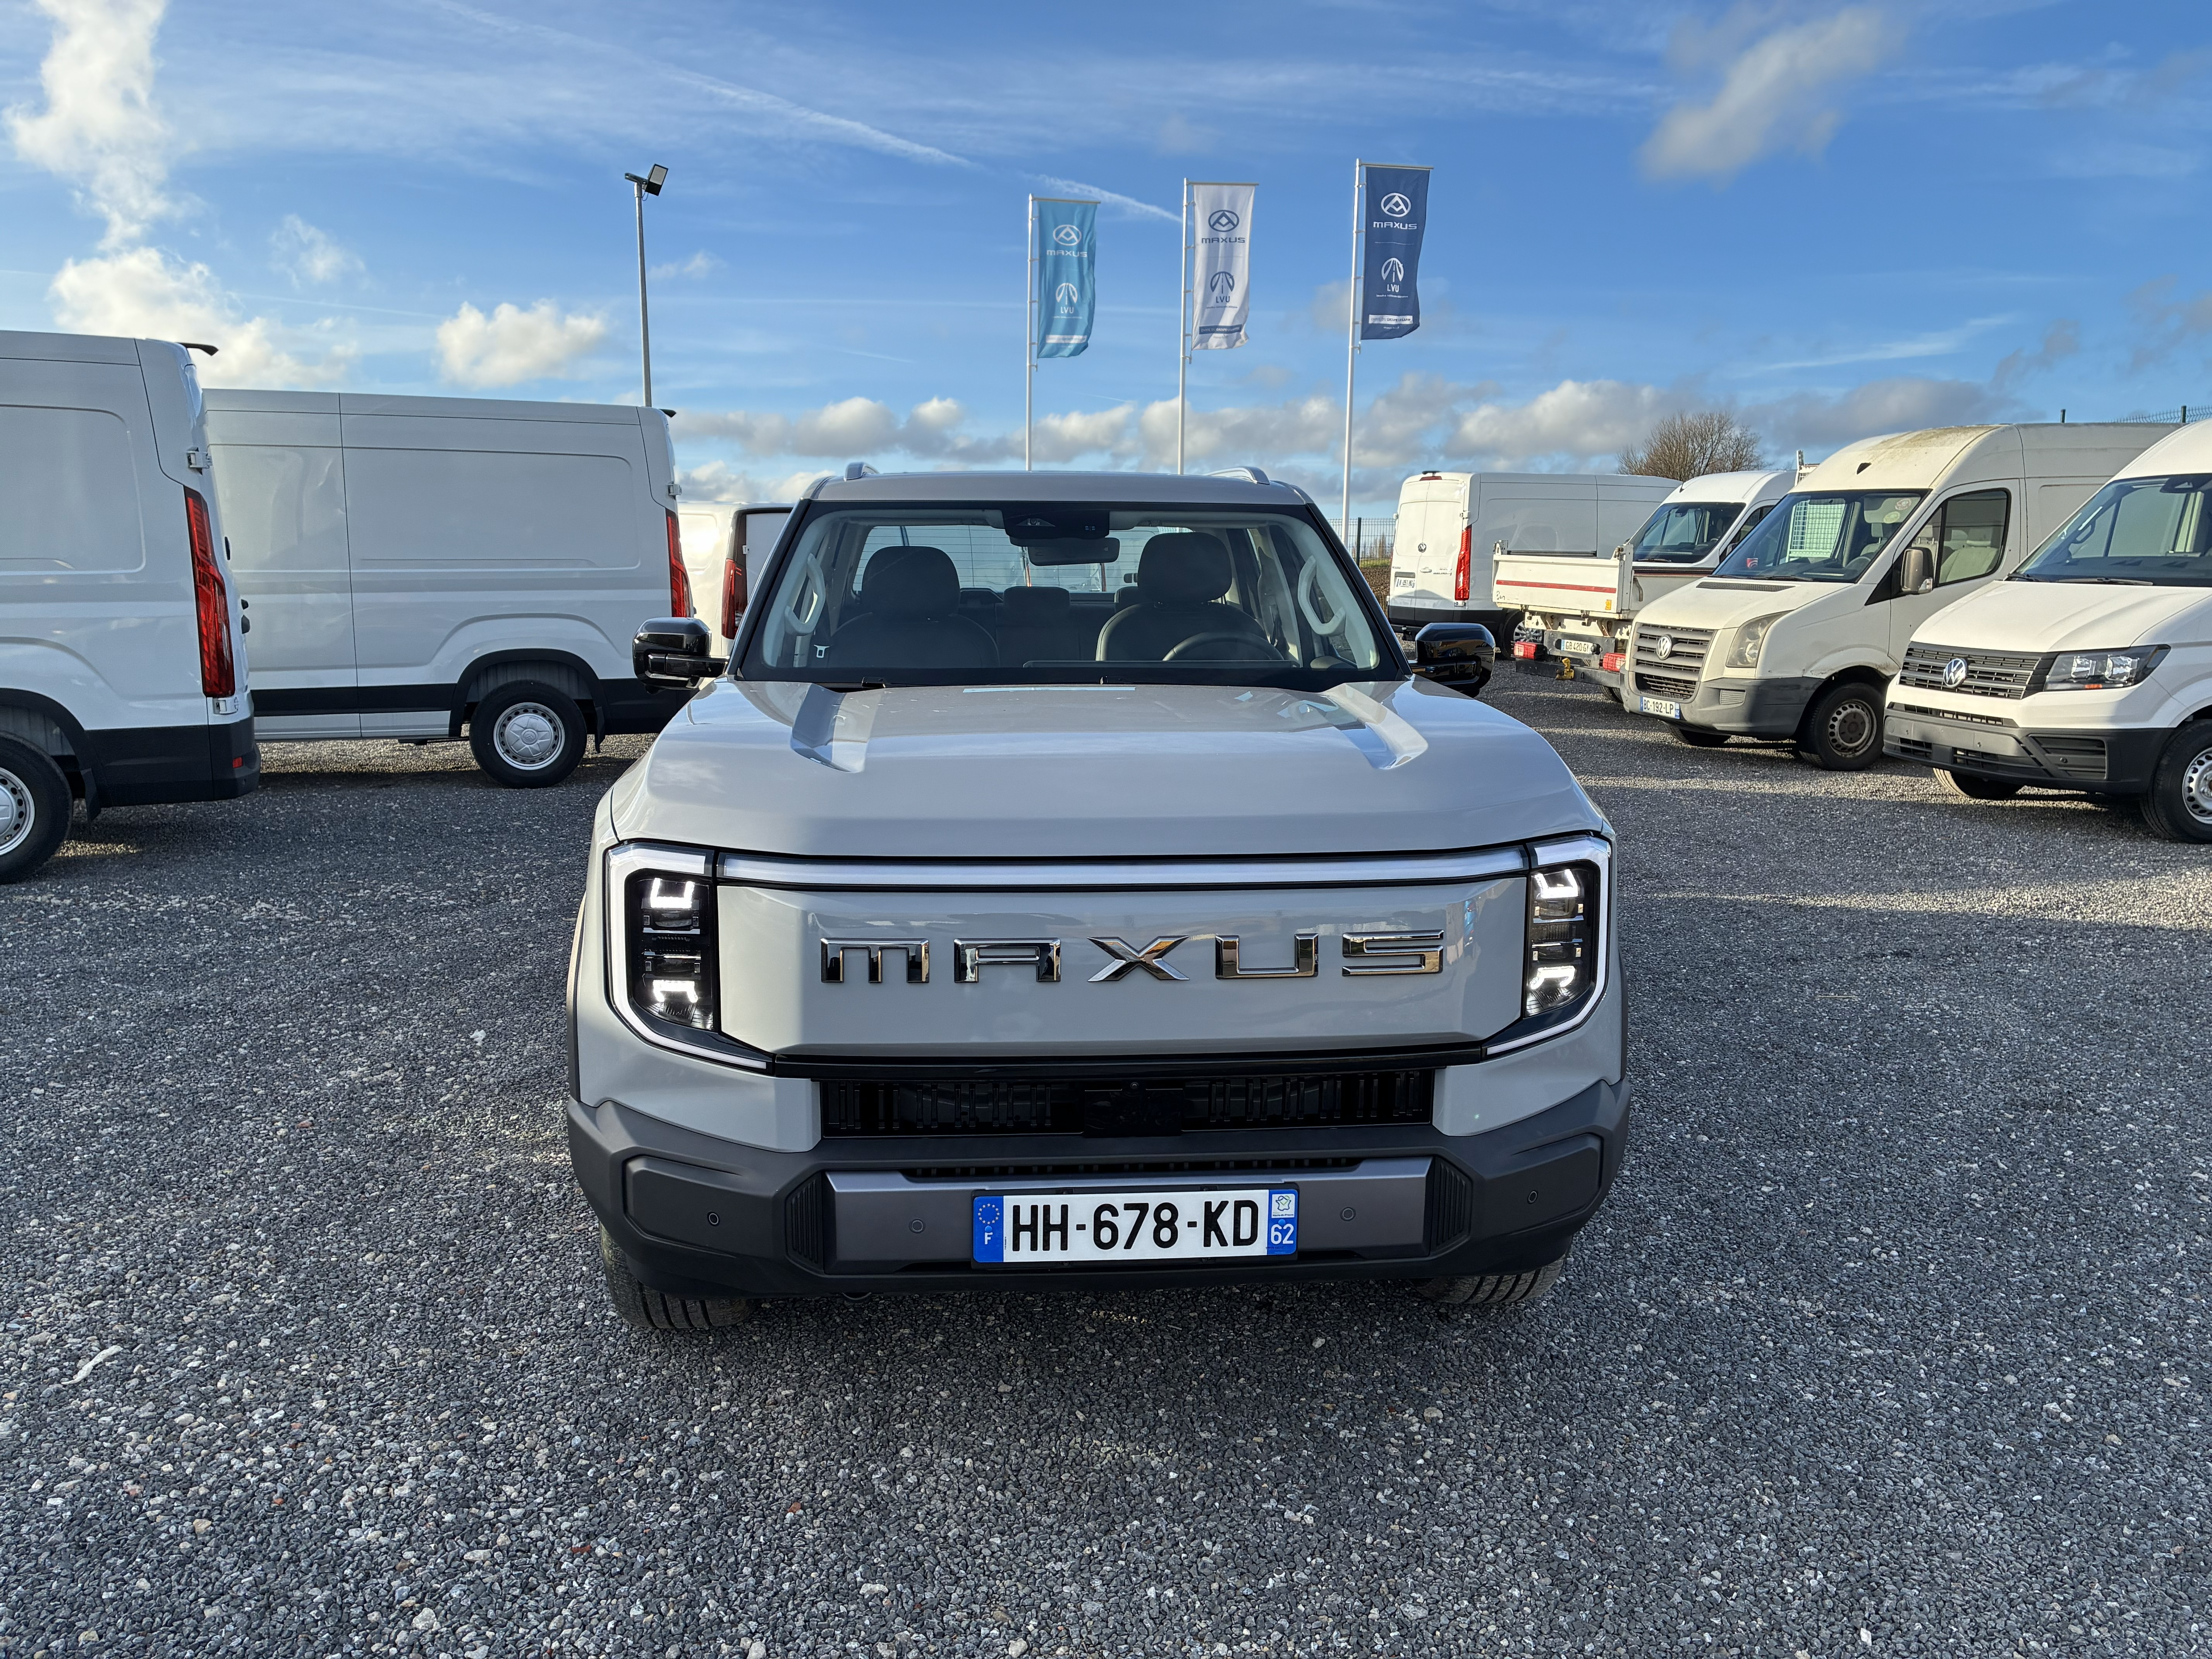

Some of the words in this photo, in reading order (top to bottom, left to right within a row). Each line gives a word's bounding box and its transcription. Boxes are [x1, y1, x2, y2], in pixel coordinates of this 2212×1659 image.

[1373, 222, 1417, 230] MAXUS
[1387, 284, 1399, 292] LVU
[1644, 699, 1674, 714] BC-192-LP
[820, 929, 1444, 983] MAXUS
[1012, 1200, 1259, 1251] HH-678-KD
[985, 1232, 993, 1244] F
[1271, 1223, 1294, 1244] 62
